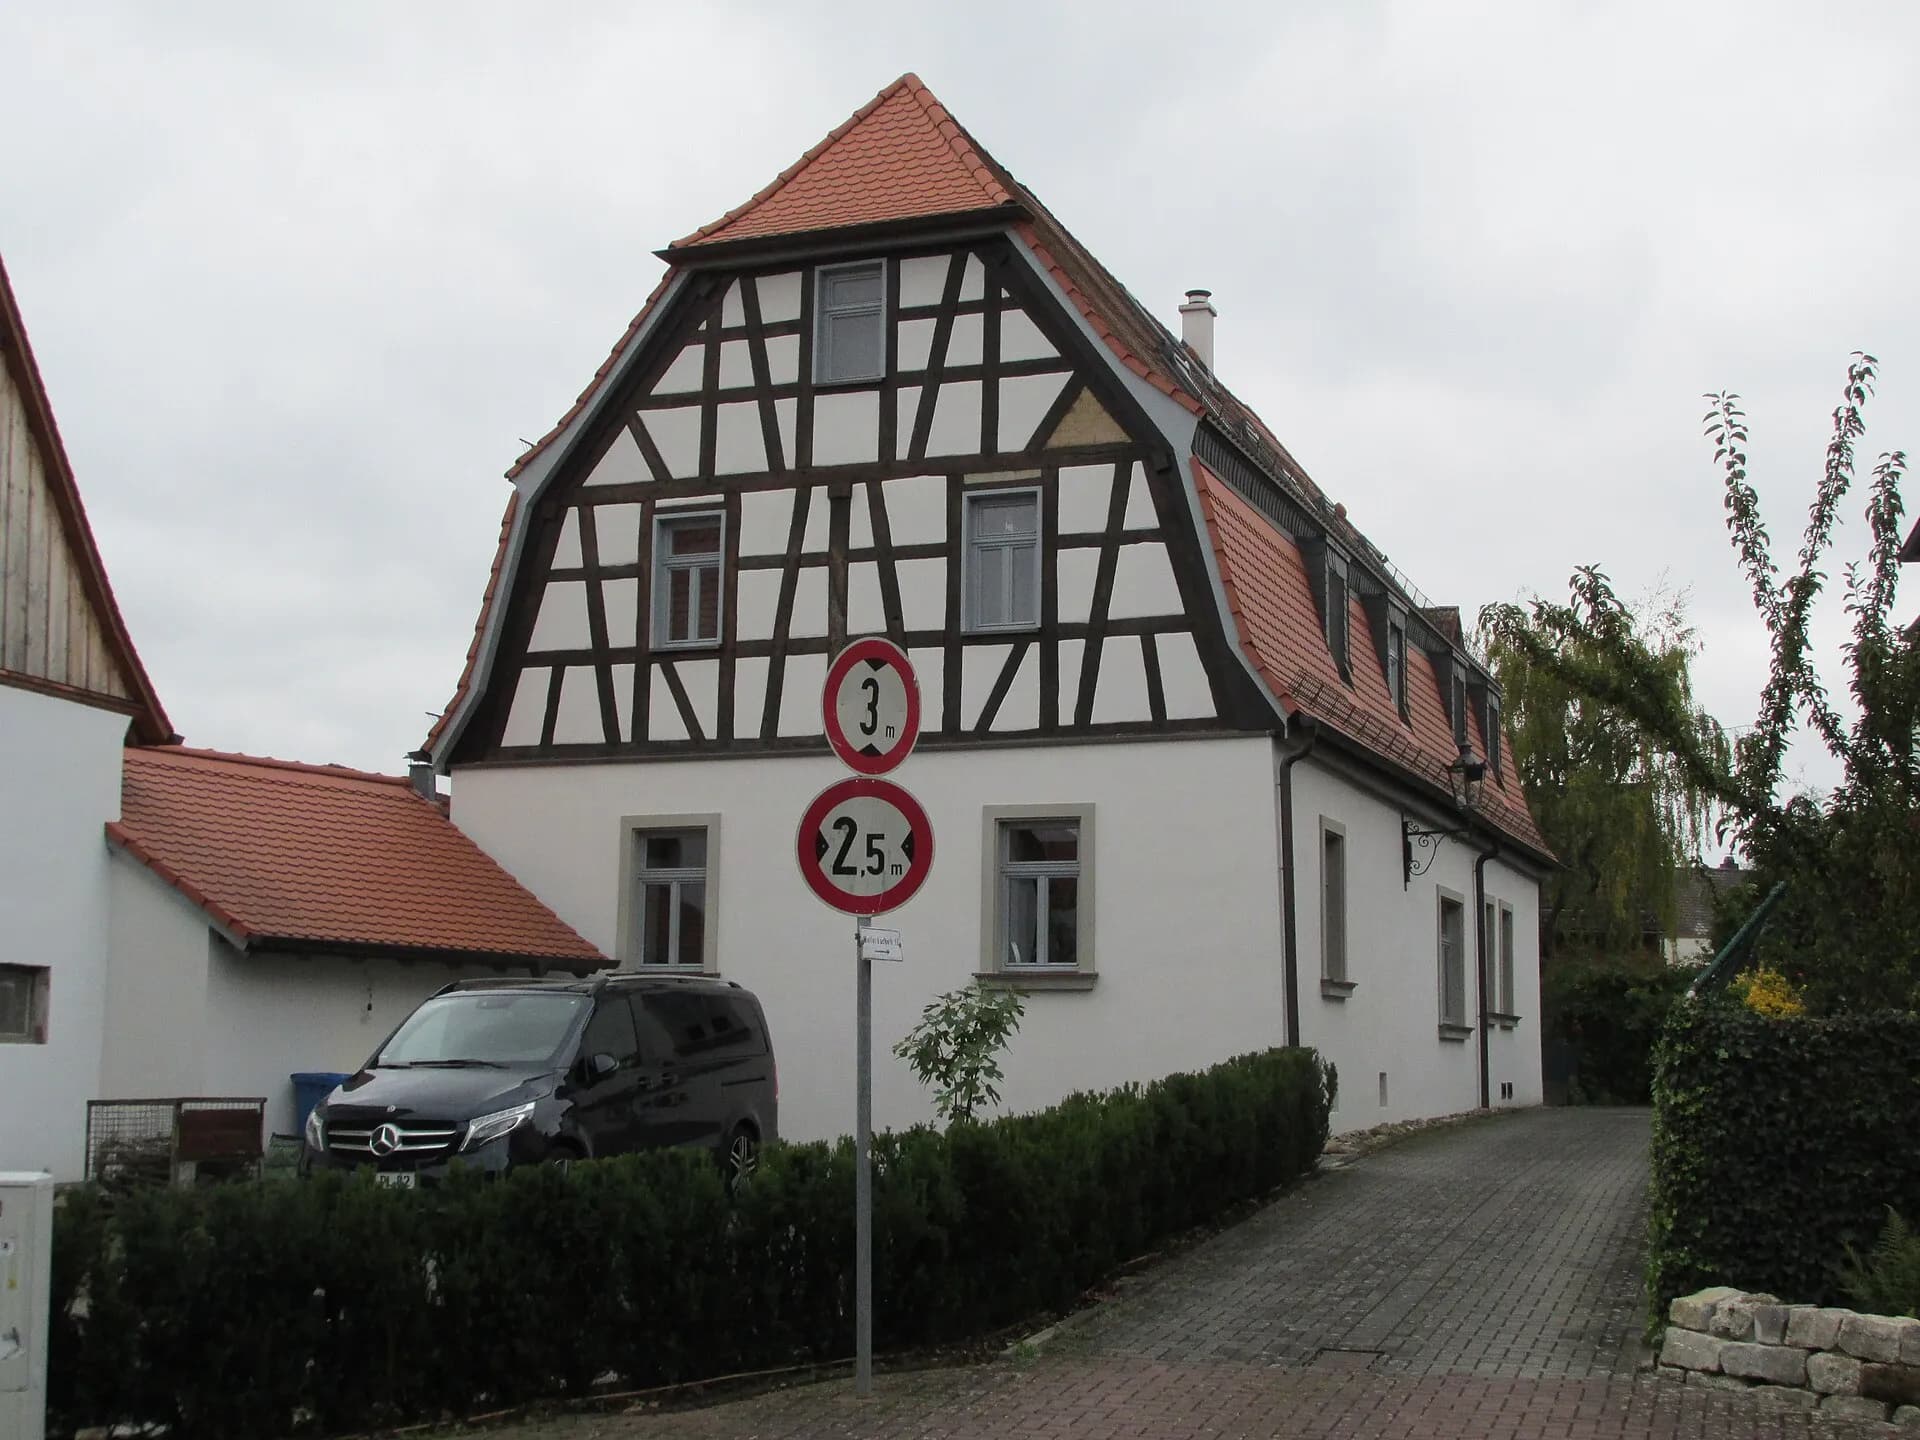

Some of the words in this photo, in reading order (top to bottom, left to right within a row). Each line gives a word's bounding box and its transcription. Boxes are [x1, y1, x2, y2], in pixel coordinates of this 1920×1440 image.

[859, 677, 879, 736] 3
[885, 724, 896, 739] m
[832, 816, 885, 878] 2,5
[890, 862, 903, 876] m
